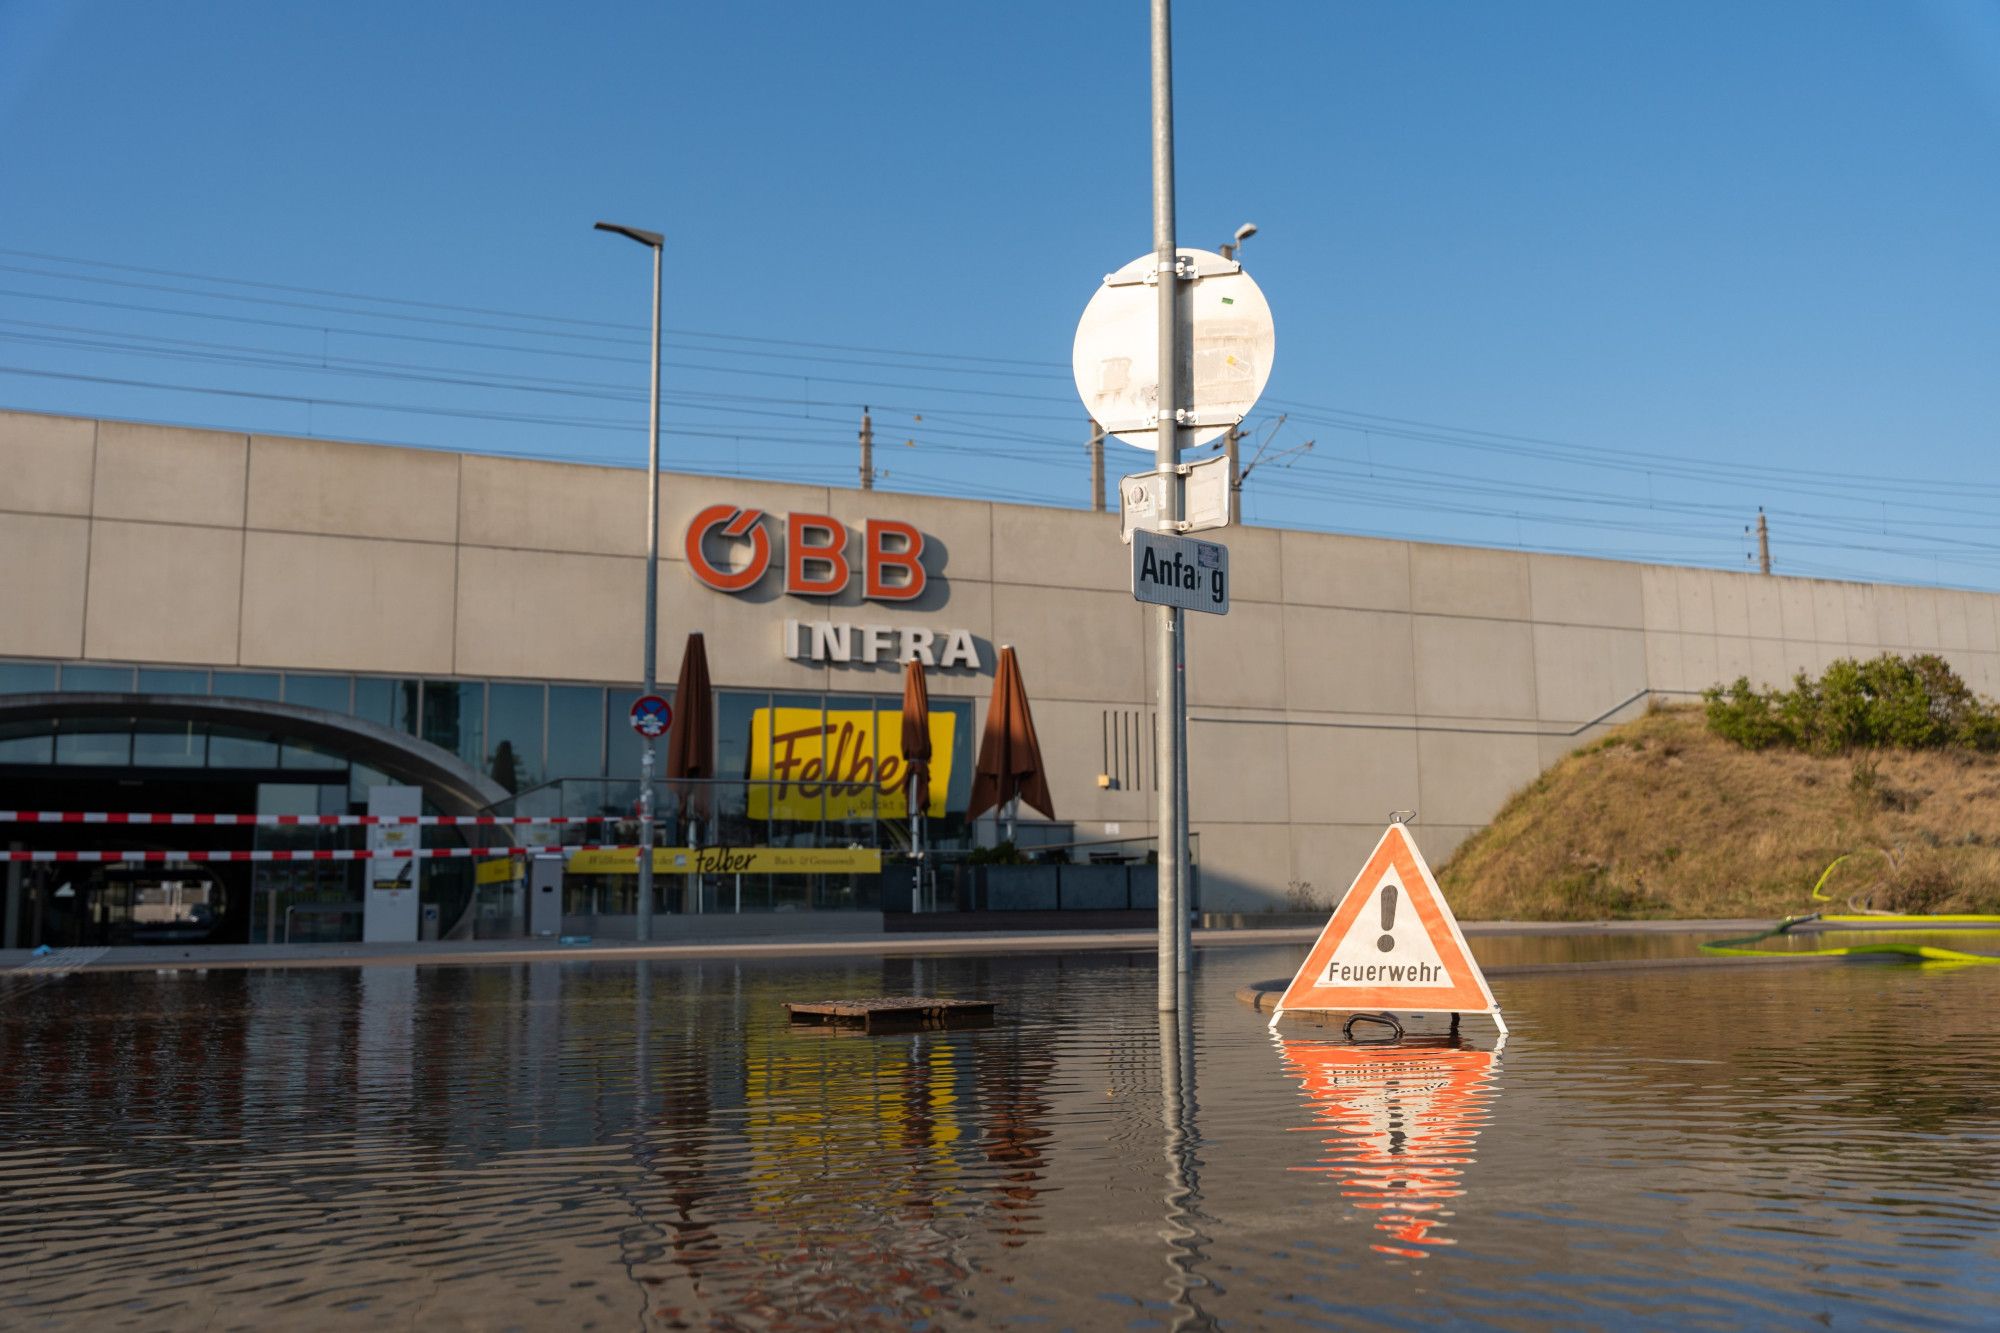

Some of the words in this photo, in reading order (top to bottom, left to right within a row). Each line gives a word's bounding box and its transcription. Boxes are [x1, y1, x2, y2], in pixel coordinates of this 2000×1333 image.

[685, 504, 927, 600] ÖBB
[1140, 546, 1224, 603] Anfag
[784, 619, 981, 668] INFRA
[772, 720, 908, 801] Felbe
[695, 845, 757, 874] Felber
[1328, 962, 1441, 982] Feuerwehr
